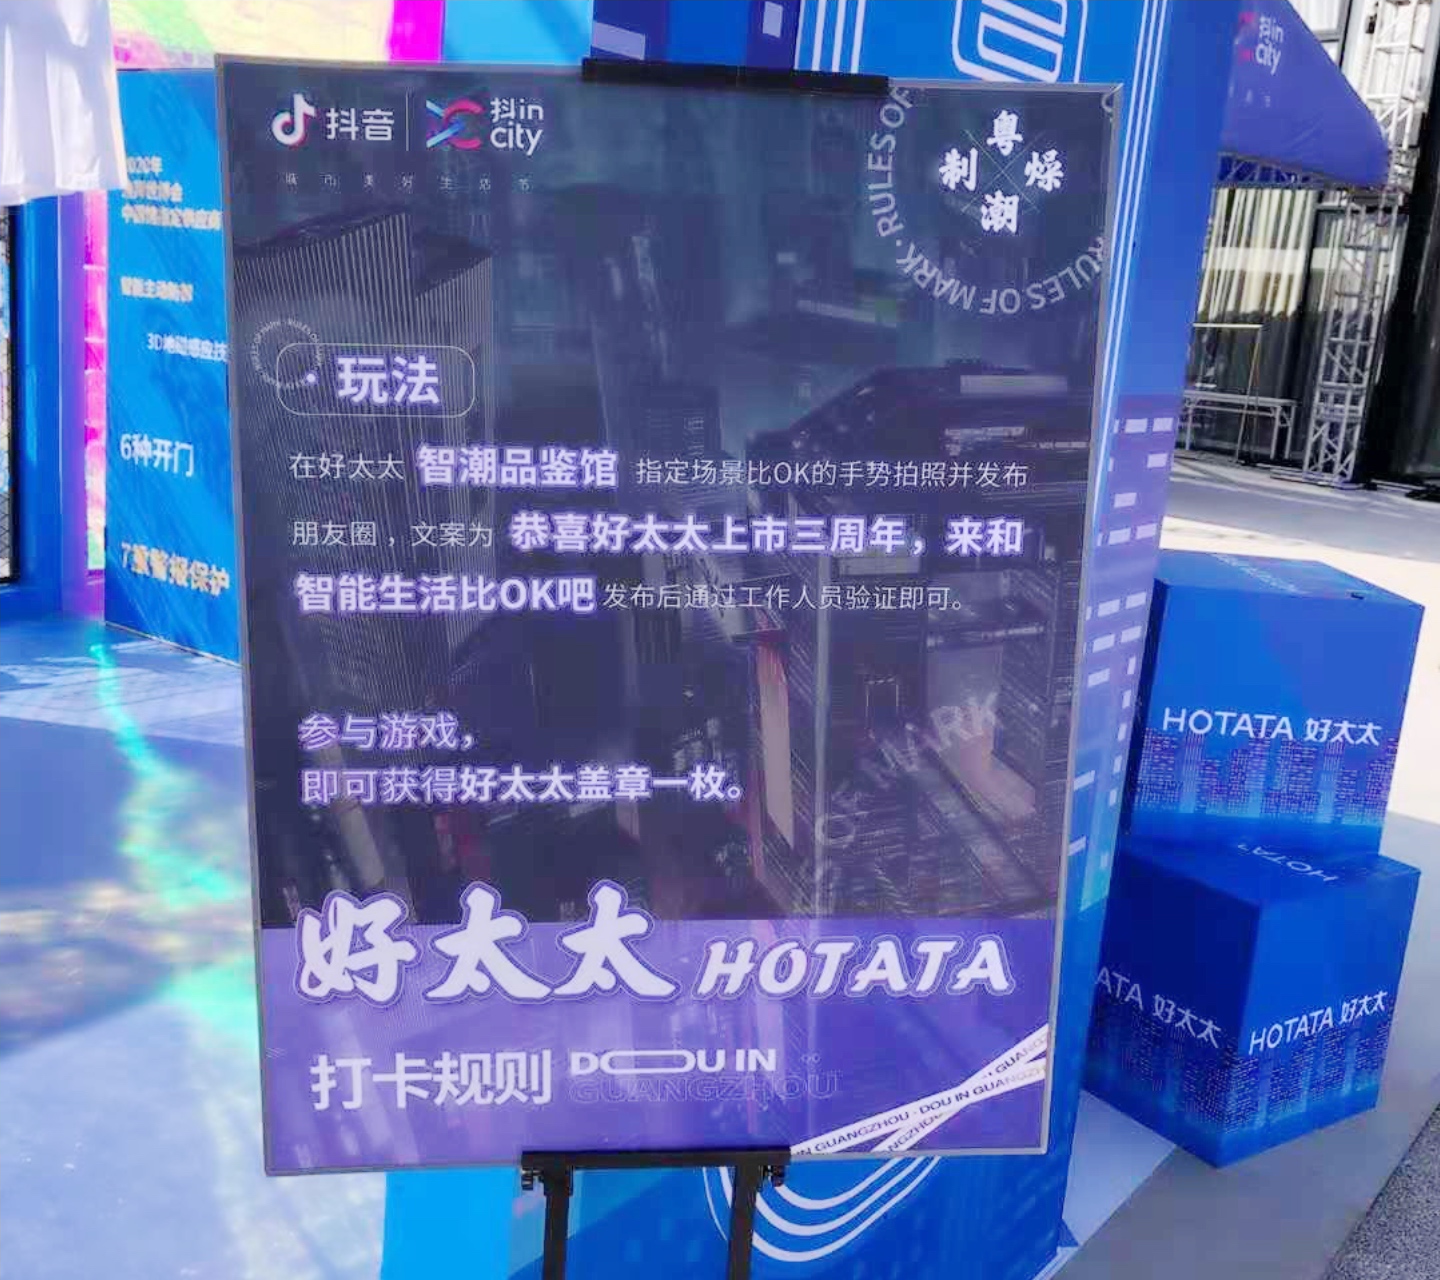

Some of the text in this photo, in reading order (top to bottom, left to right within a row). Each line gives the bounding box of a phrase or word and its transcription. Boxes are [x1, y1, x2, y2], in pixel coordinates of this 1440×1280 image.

[326, 107, 395, 141] 抖音
[490, 97, 544, 123] 抖in
[490, 121, 545, 156] city
[986, 109, 1023, 156] 粤
[867, 132, 905, 237] RULES
[939, 146, 979, 191] 制
[980, 190, 1020, 233] 潮
[337, 354, 440, 404] 玩法
[120, 433, 194, 477] 6种开门
[288, 446, 1029, 489] 在好太太 智潮品鉴馆 指定场景比OK的手势拍照并发布
[511, 513, 1024, 556] 恭喜好太太上市三周年，来和
[295, 574, 962, 614] 智能生活比OK吧 发布后通过工作人员验证即可。
[1163, 707, 1382, 746] HOTATA 好太太
[301, 765, 746, 804] 即可获得好太太盖章一枚。
[299, 884, 1010, 1002] 好太太 HOTATA
[1152, 993, 1222, 1048] 好太太
[1248, 990, 1389, 1056] HOTATA 好太太
[310, 1049, 552, 1111] 打卡规则
[734, 1047, 777, 1073] IN
[815, 1111, 910, 1152] GUANGZHOU
[919, 1096, 952, 1115] DOU
[955, 1090, 970, 1103] IN
